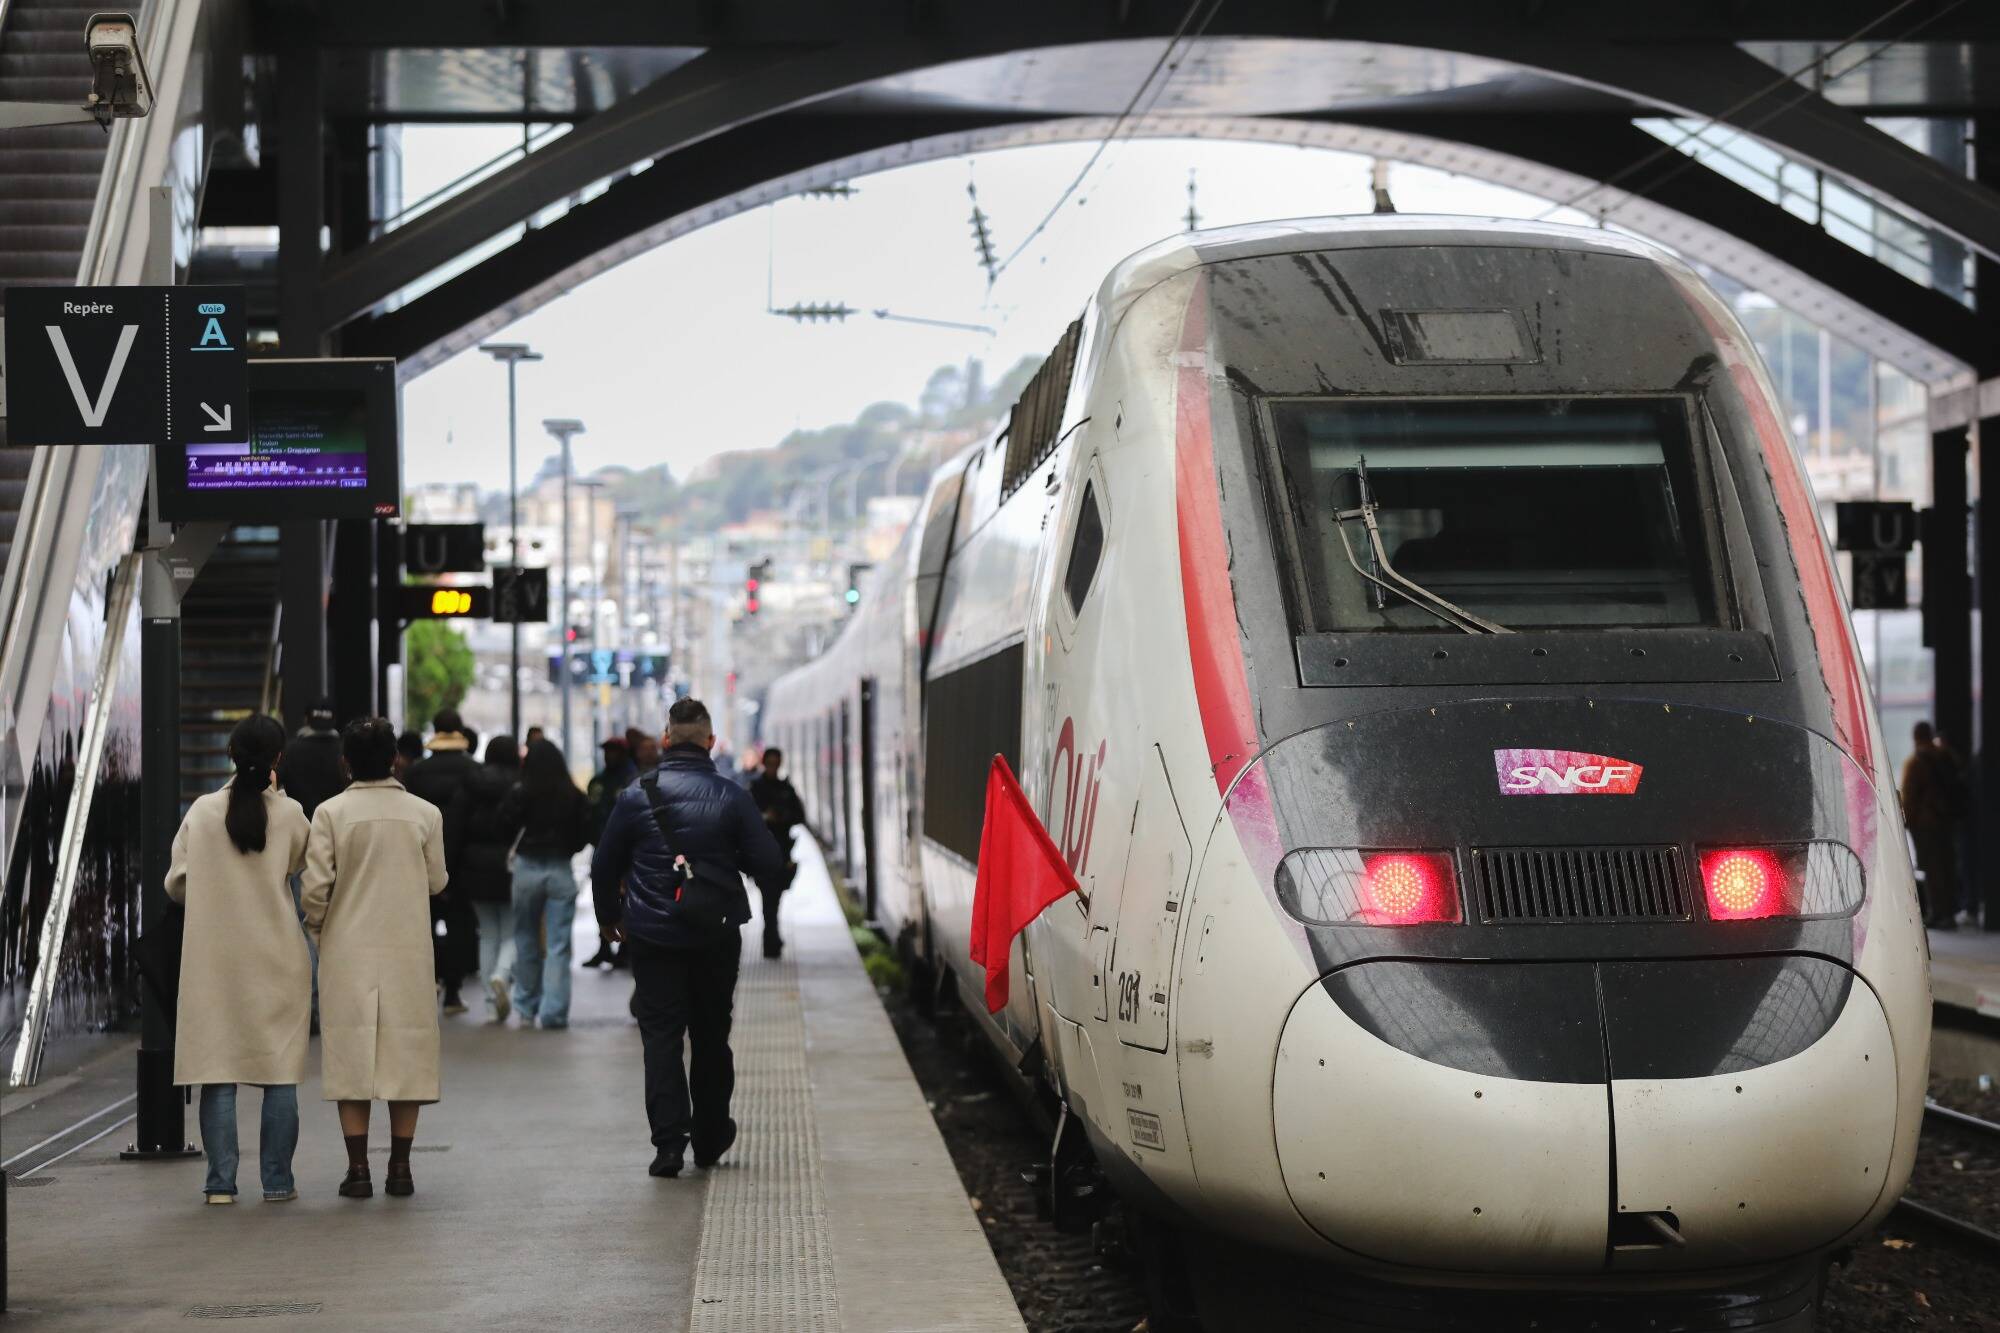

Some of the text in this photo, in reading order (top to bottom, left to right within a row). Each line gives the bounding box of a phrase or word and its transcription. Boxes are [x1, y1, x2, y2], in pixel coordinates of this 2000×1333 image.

[63, 301, 114, 316] Repère
[201, 304, 223, 313] Voie
[200, 318, 228, 346] A
[45, 325, 140, 427] V
[1873, 513, 1903, 549] U
[417, 533, 447, 569] U
[1506, 766, 1633, 789] SNCF
[1118, 971, 1141, 1024] 291
